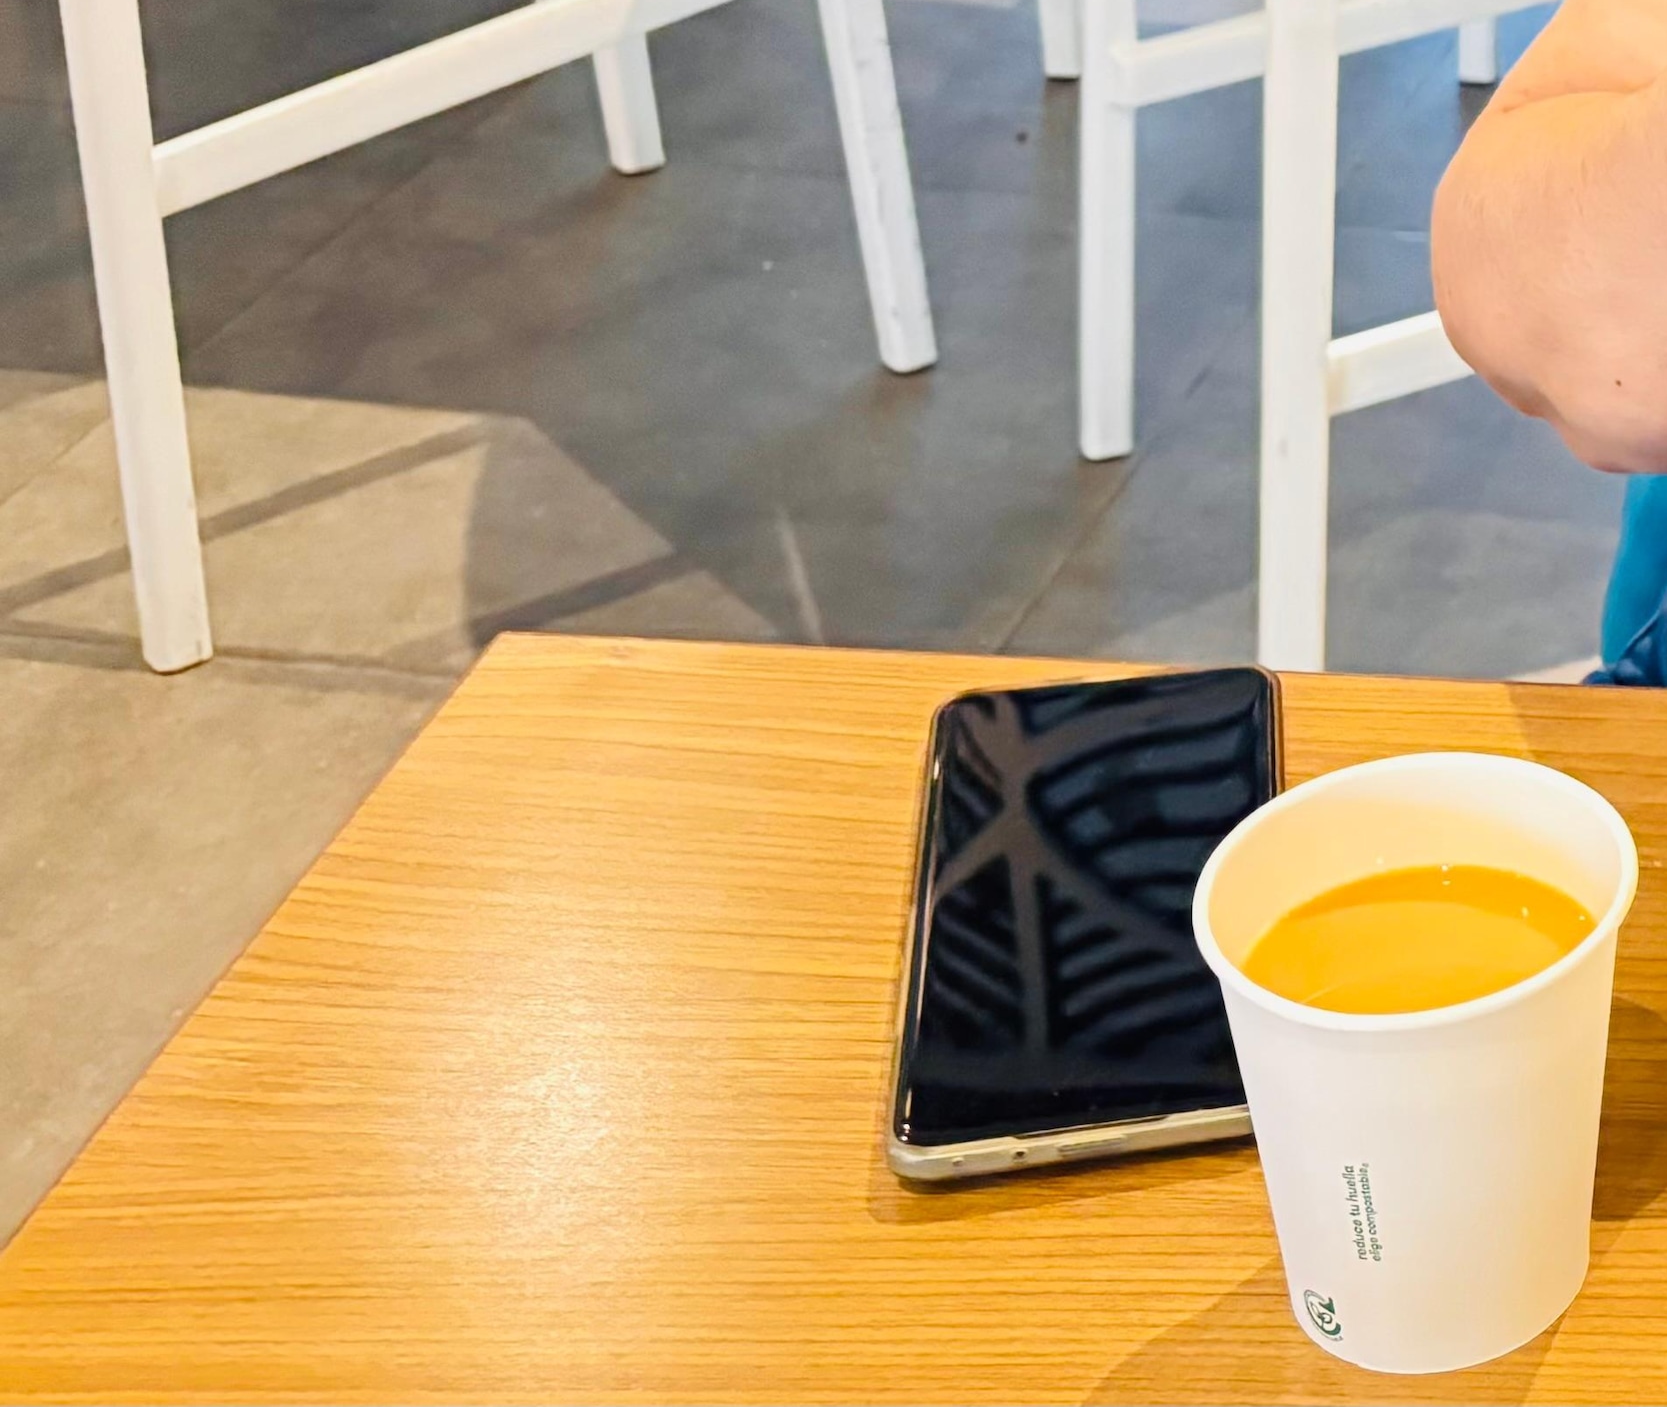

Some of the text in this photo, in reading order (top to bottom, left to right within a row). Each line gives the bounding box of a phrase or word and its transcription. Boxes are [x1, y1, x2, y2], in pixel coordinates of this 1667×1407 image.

[1342, 1165, 1368, 1261] reduce tu huella
